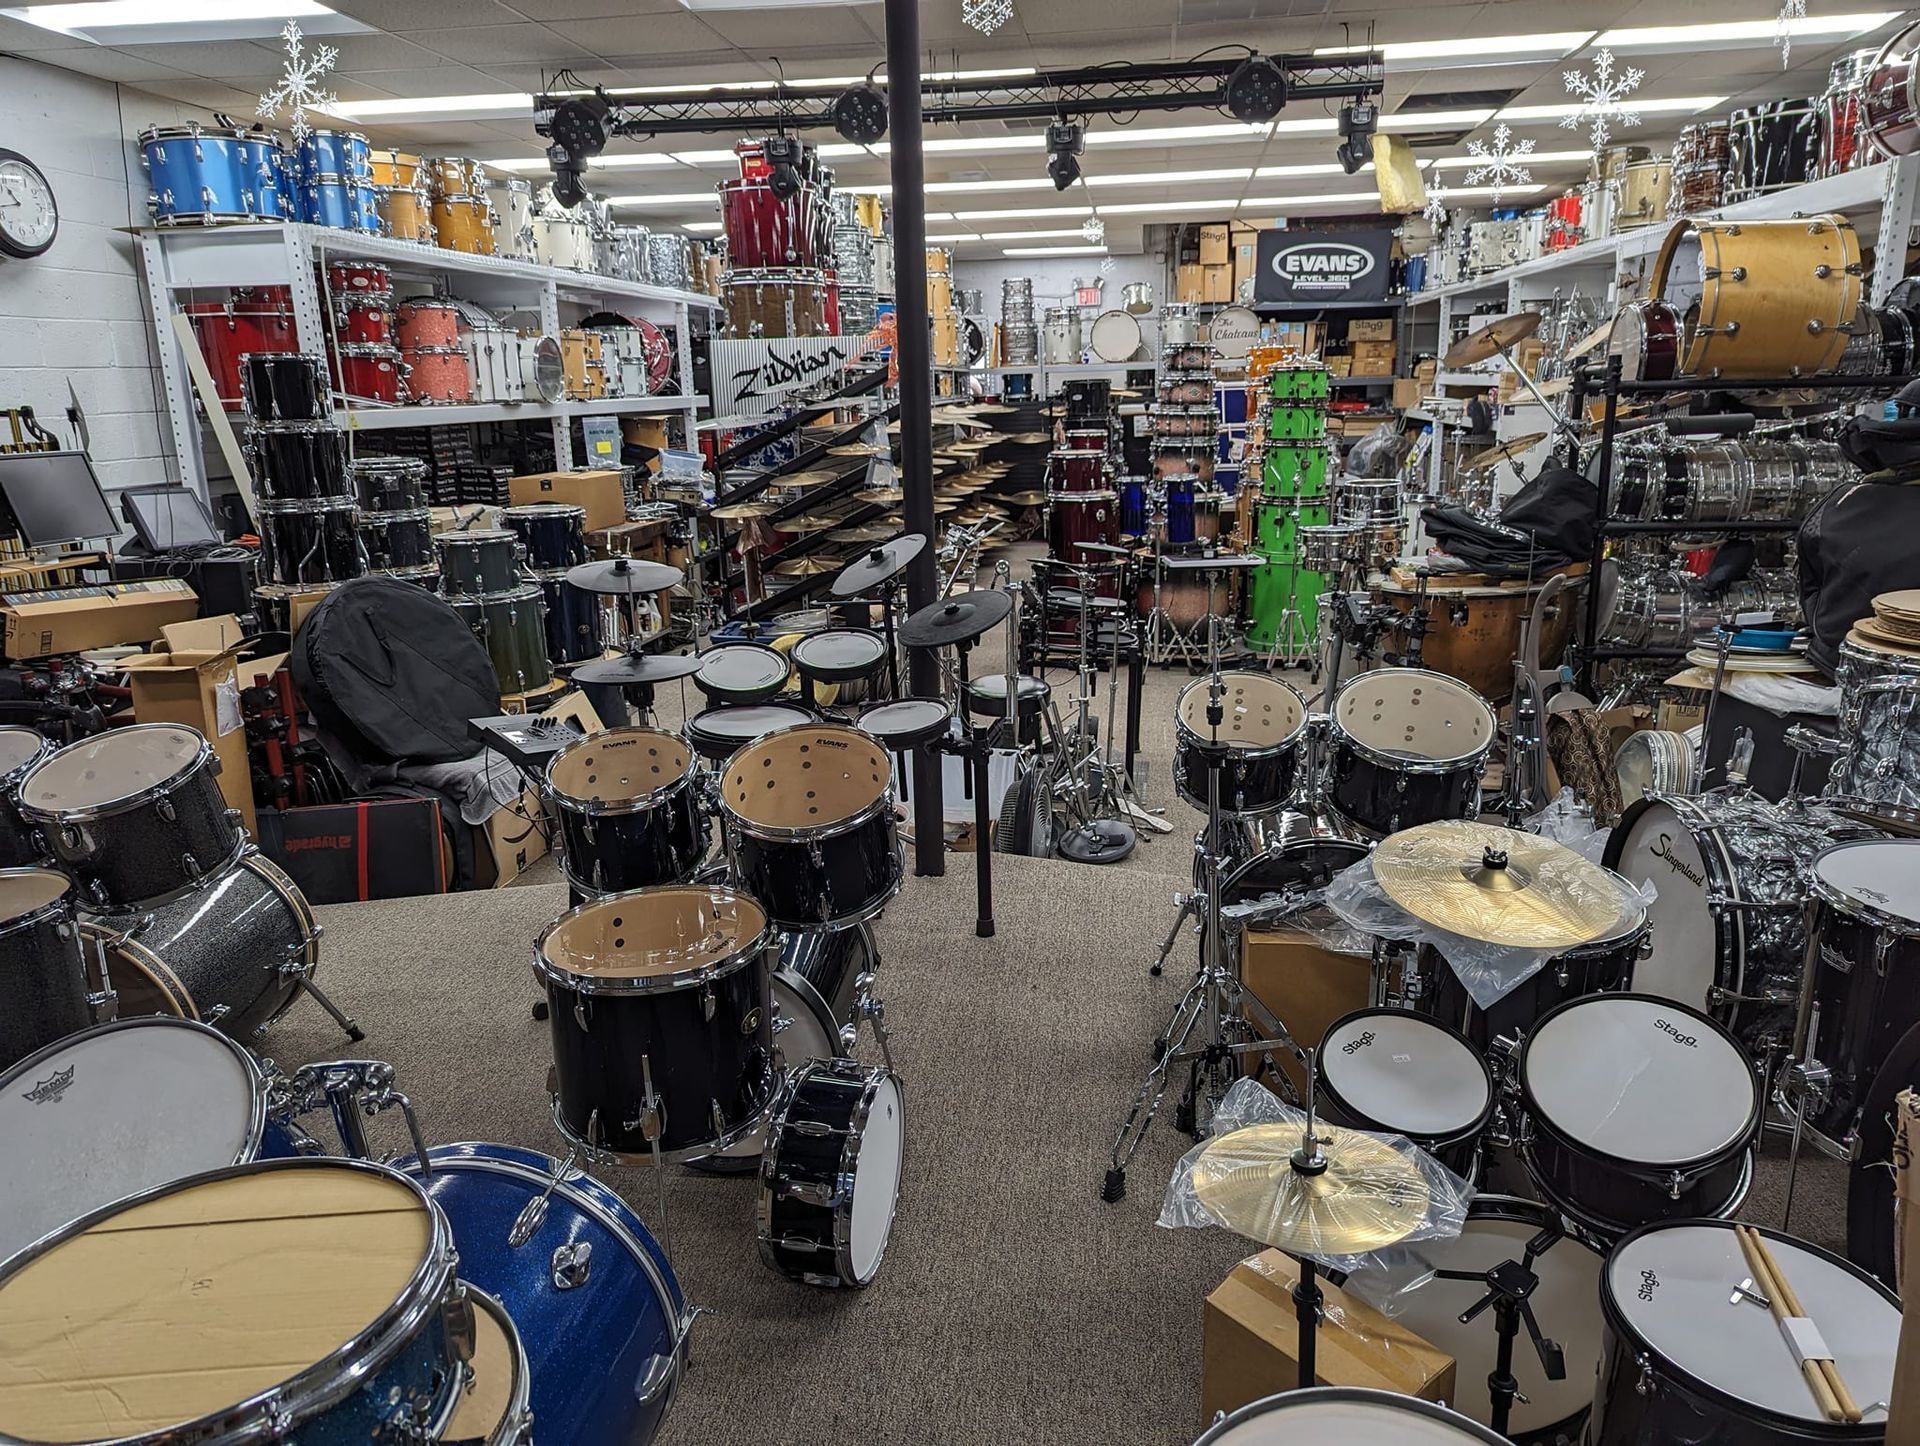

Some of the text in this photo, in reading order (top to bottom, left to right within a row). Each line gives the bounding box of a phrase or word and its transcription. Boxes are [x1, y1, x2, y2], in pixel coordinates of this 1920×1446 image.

[1286, 255, 1361, 272] EVANS
[1294, 275, 1351, 283] LEVEL 360
[1080, 290, 1097, 305] EXIT
[732, 343, 847, 404] Zildjian
[602, 739, 638, 750] EVANS
[815, 738, 849, 749] EVANS
[1650, 833, 1705, 888] Slingerland
[1342, 1031, 1375, 1055] Stagg
[1653, 1019, 1697, 1047] Stagg
[1638, 1270, 1660, 1302] Stagg
